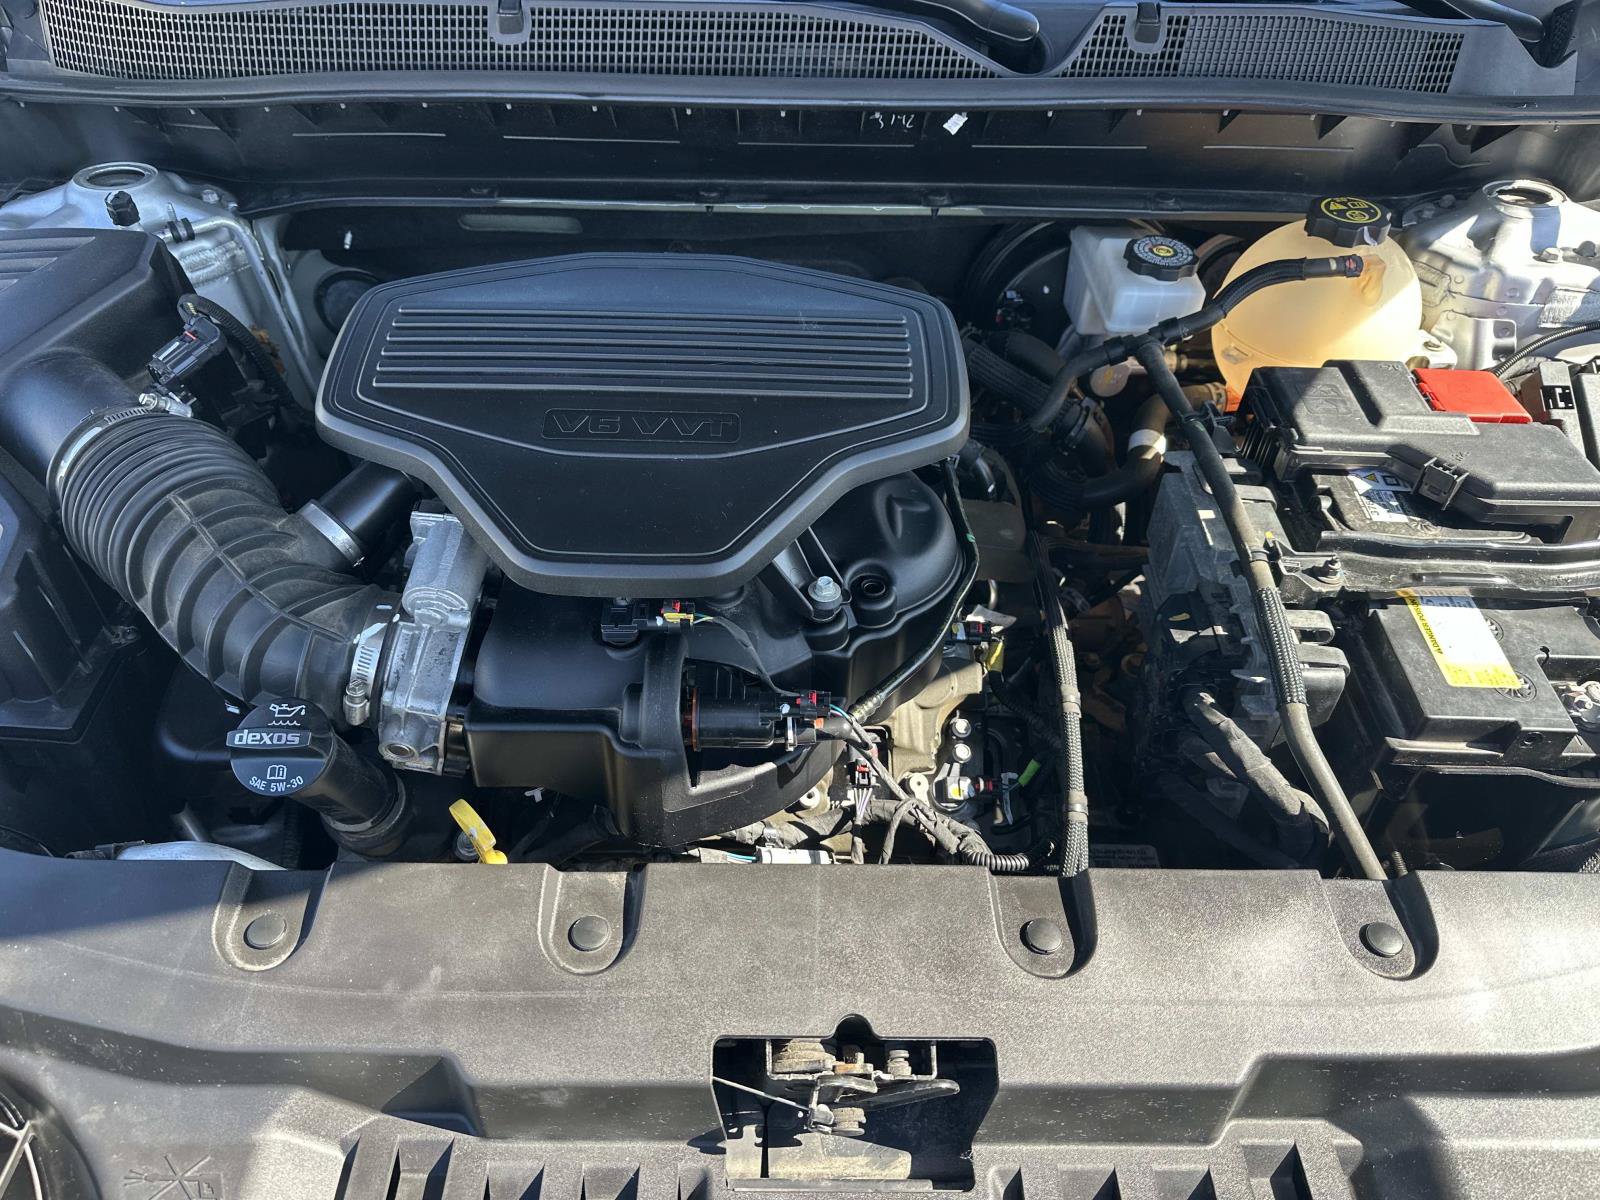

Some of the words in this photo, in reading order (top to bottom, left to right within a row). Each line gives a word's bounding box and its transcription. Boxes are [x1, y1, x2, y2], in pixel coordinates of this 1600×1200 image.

[553, 415, 620, 434] V6
[632, 416, 734, 437] VVT
[234, 729, 301, 745] dexos
[249, 776, 267, 791] SAE
[270, 776, 304, 792] 5W-30
